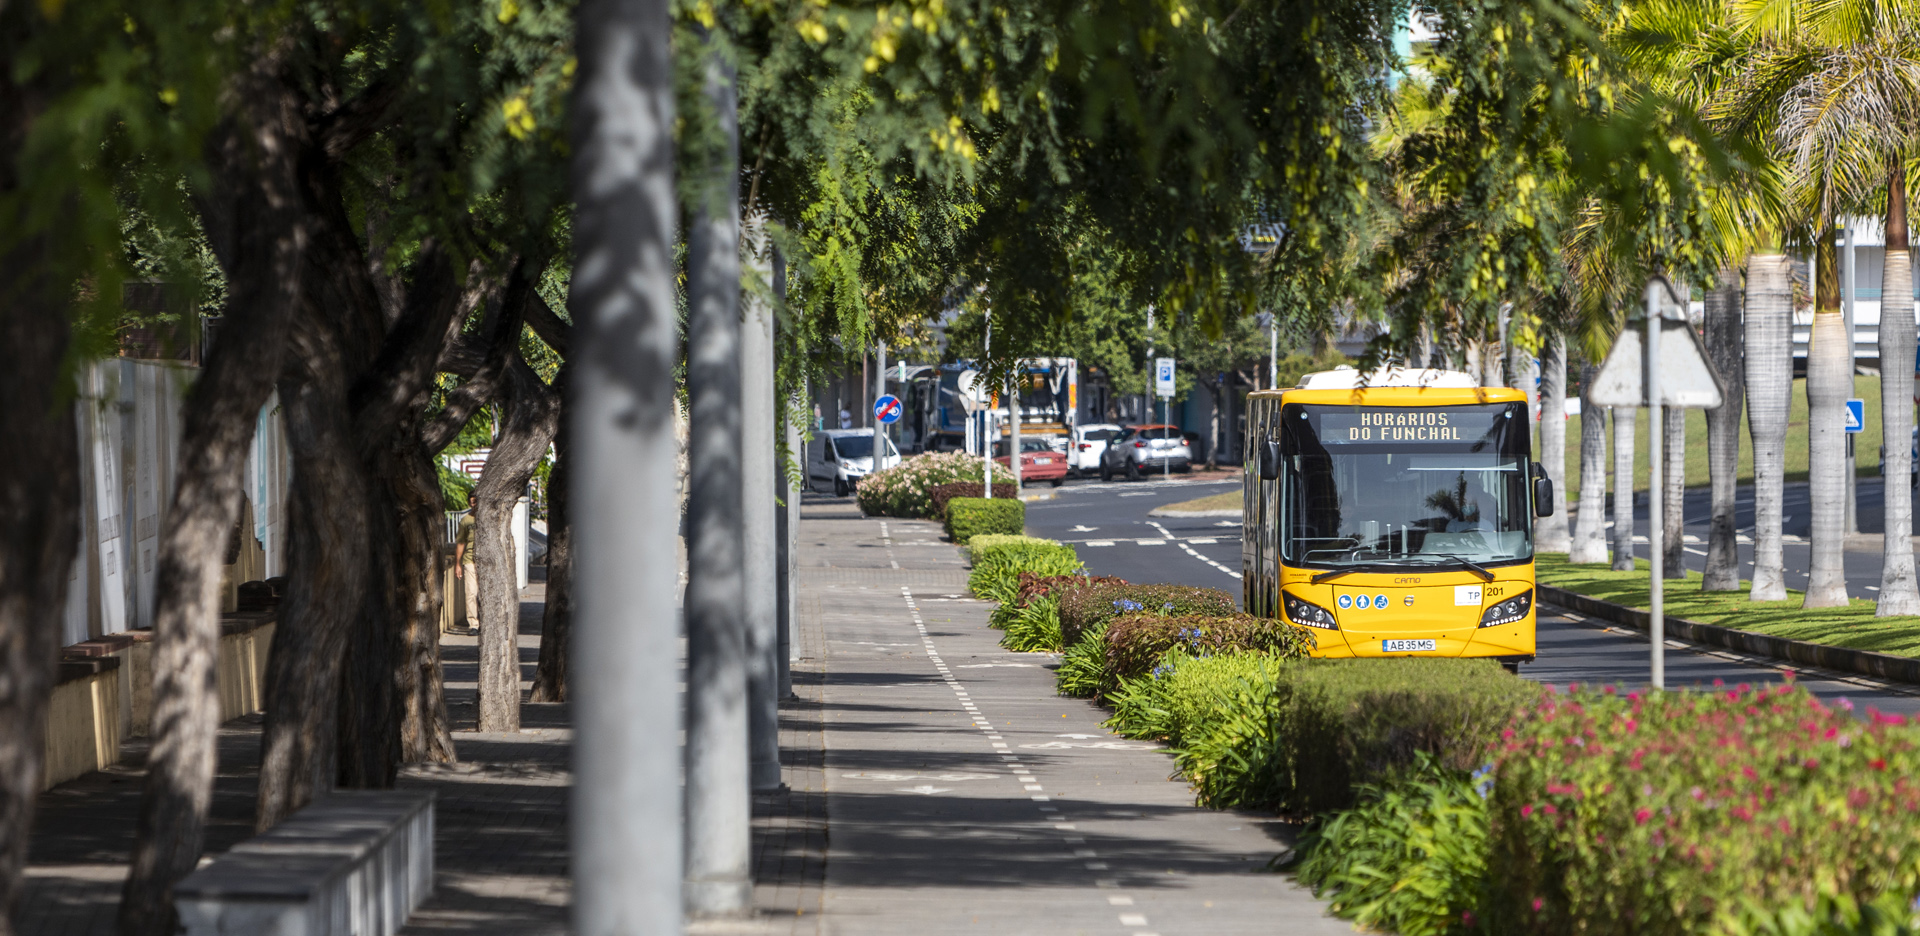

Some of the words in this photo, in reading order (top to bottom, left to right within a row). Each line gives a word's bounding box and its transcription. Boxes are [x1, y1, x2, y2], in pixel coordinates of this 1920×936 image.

[1361, 412, 1448, 426] HORÁRIOS
[1349, 427, 1371, 441] DO
[1380, 427, 1461, 441] FUNCHAL
[1467, 591, 1481, 600] TP
[1486, 587, 1504, 597] 201
